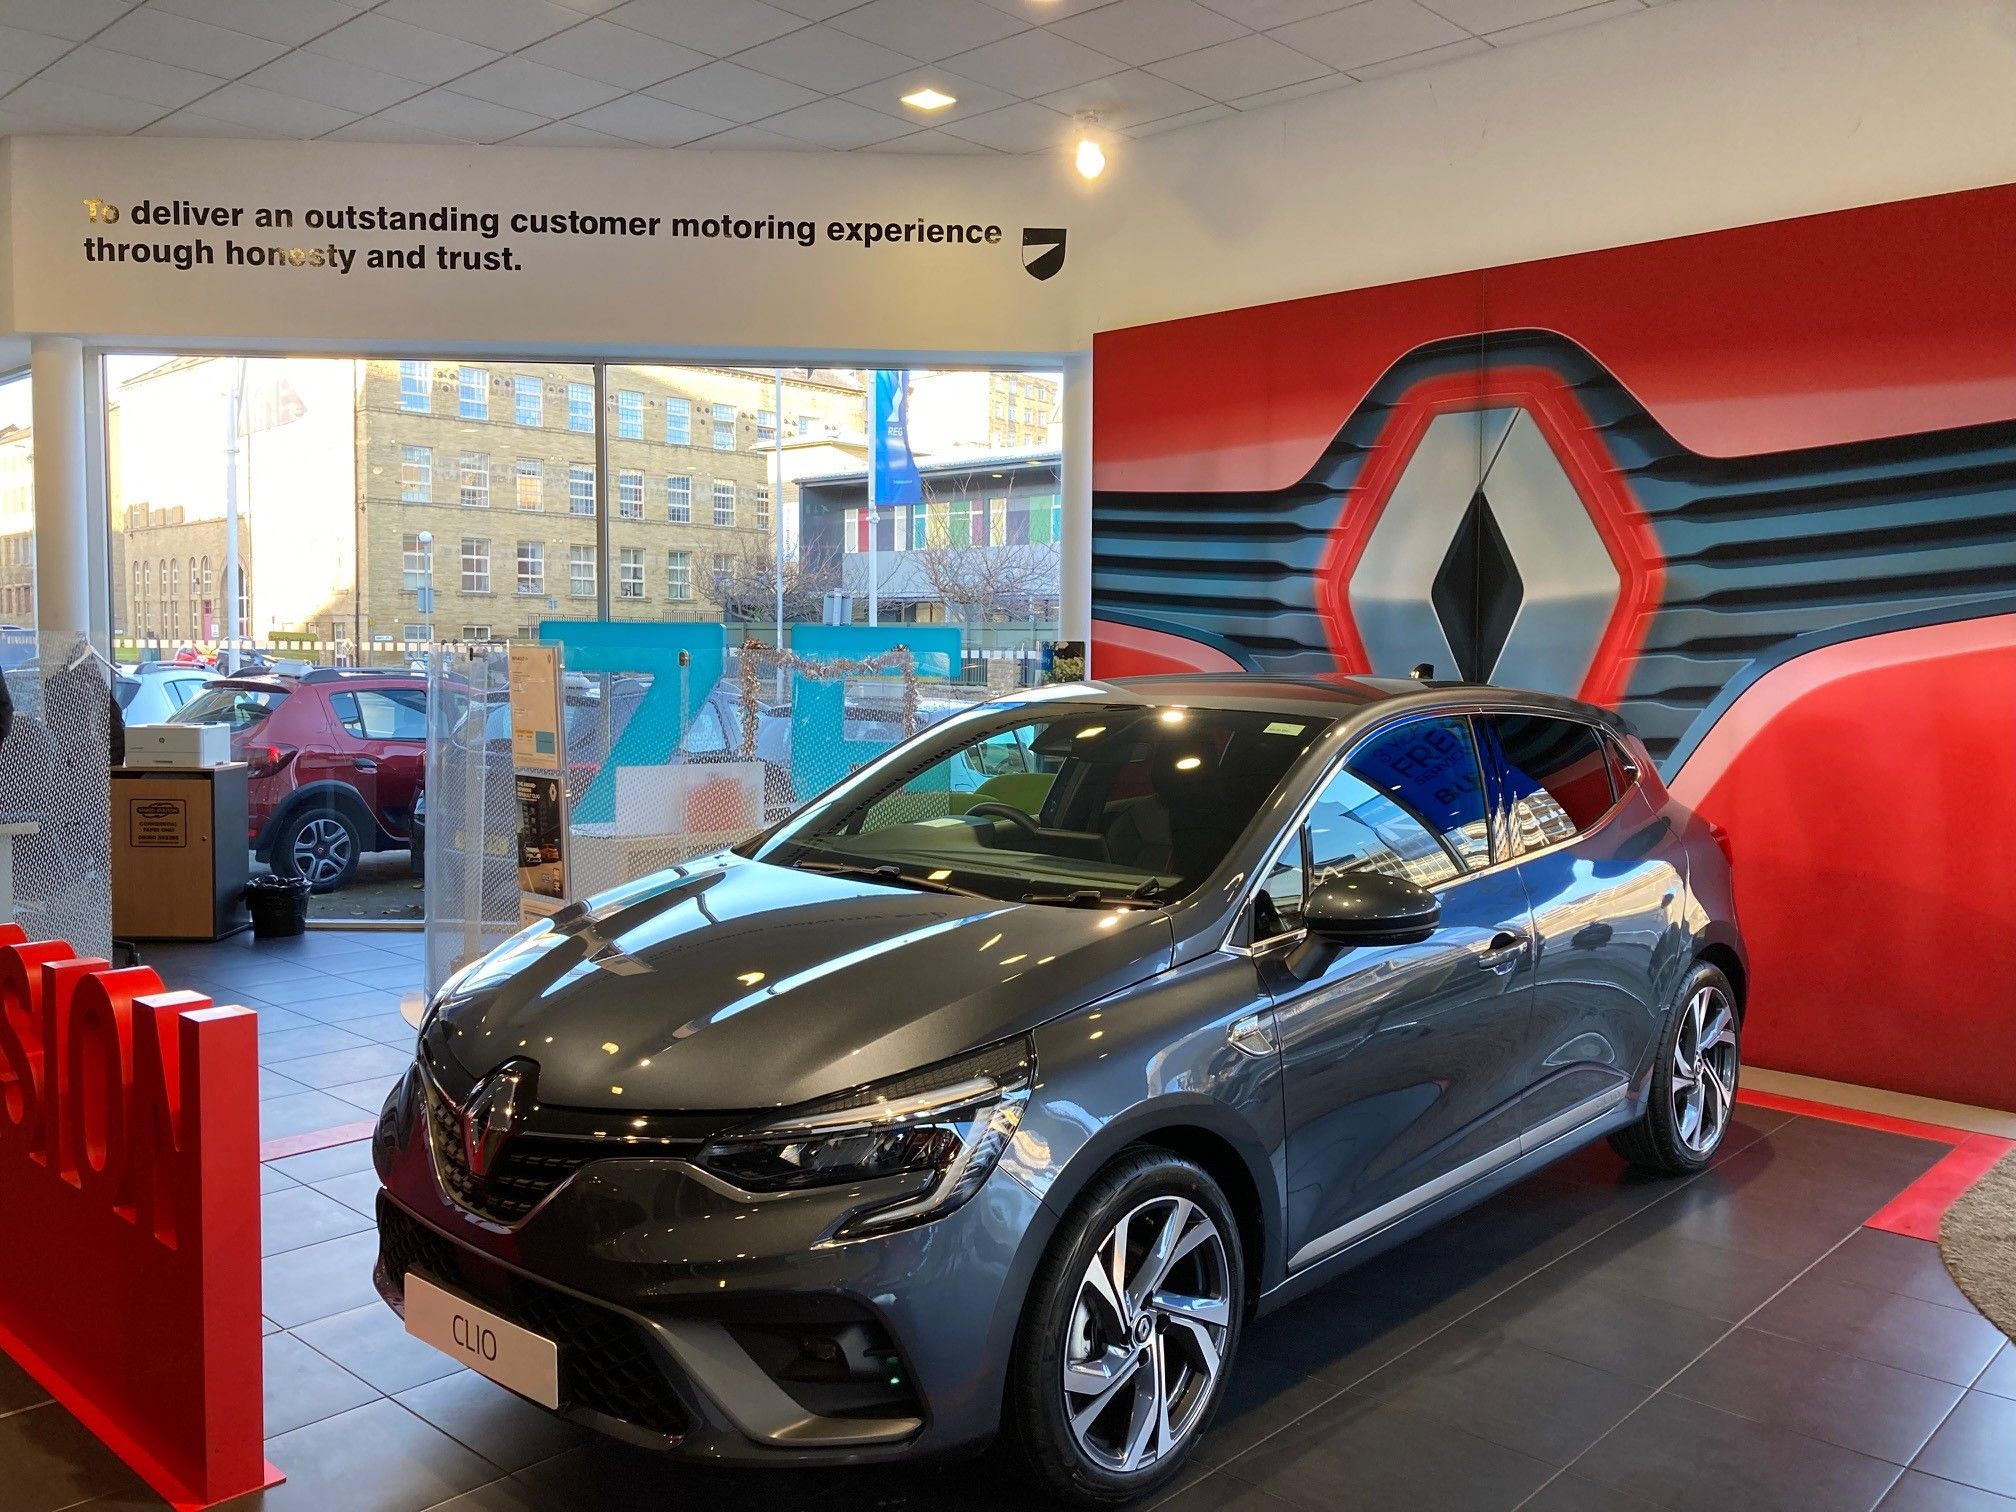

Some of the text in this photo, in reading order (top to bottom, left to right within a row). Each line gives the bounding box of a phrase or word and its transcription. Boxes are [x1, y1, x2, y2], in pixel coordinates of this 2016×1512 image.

[82, 199, 1003, 249] To deliver an outstanding customer motoring experience
[83, 236, 523, 275] through honesty and trust.
[887, 426, 904, 437] REG
[452, 1313, 497, 1362] CLIO
